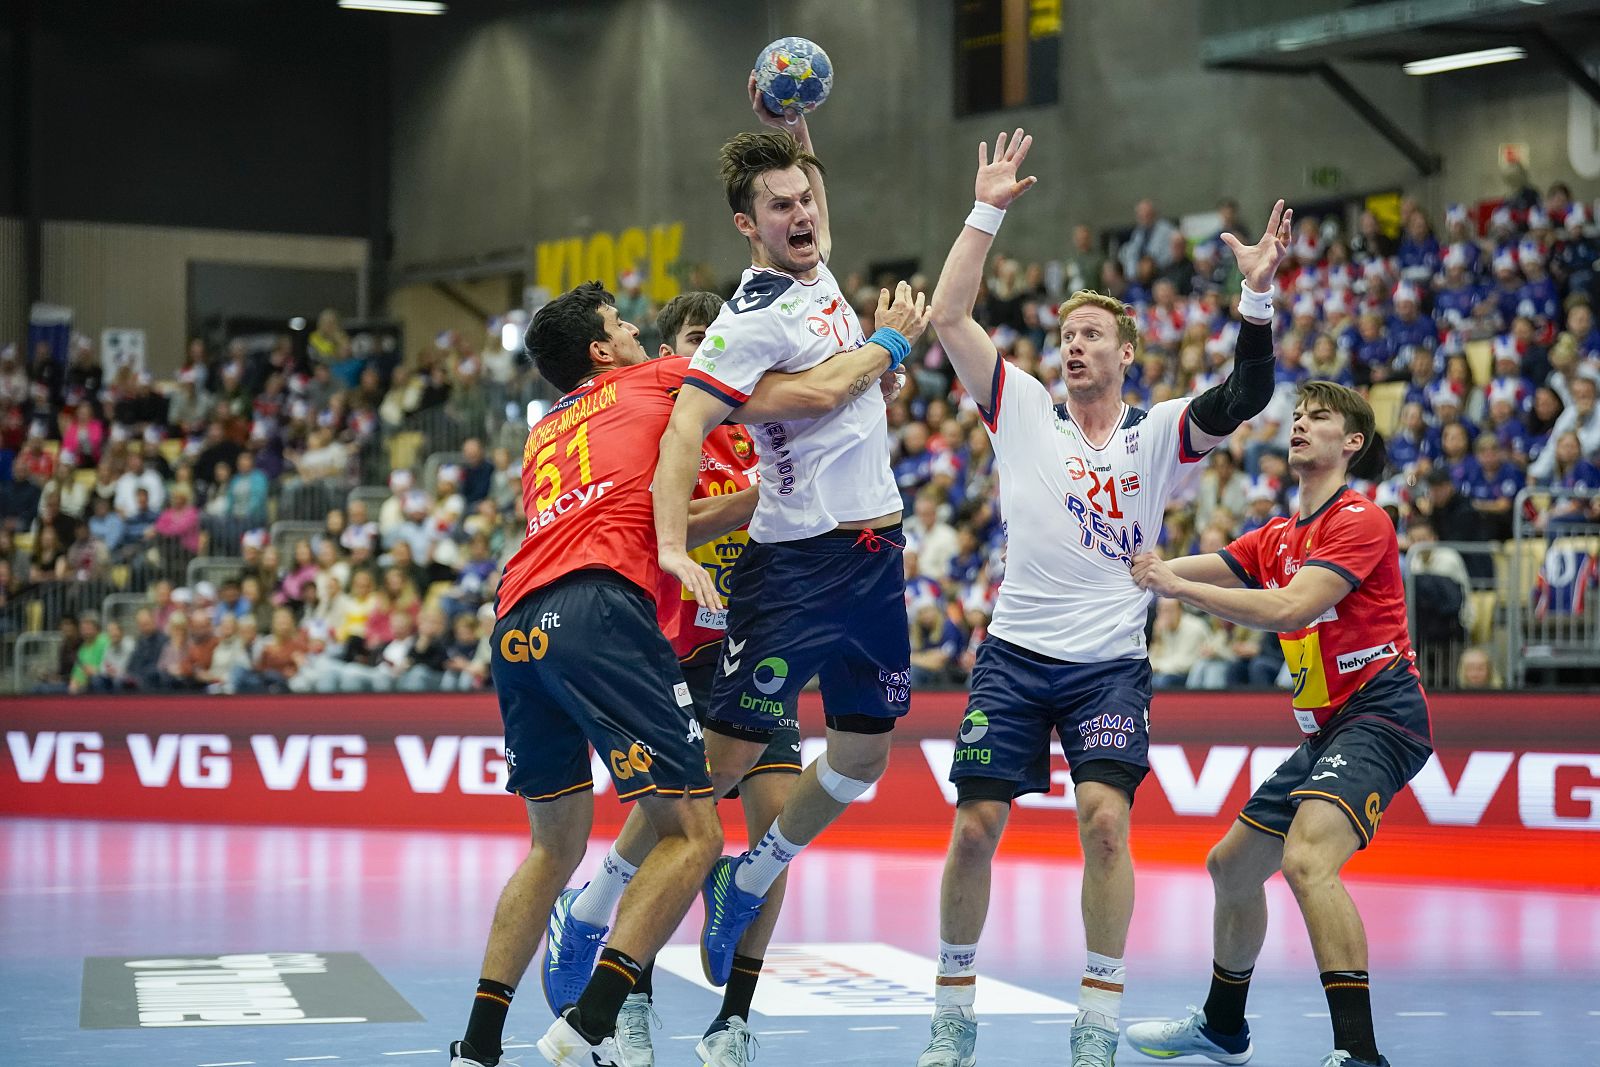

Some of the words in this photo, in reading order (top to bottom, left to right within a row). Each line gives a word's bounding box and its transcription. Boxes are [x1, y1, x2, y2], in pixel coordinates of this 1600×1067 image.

[534, 421, 592, 513] 51
[528, 481, 614, 537] sacyr
[1086, 471, 1124, 519] 21
[1065, 493, 1144, 556] REMA
[540, 611, 561, 631] fit
[501, 626, 549, 663] GO
[739, 692, 785, 717] bring
[1078, 713, 1136, 737] REMA
[1083, 731, 1128, 750] 1000
[6, 731, 104, 785] VG
[126, 733, 232, 790] VG
[249, 735, 368, 792] VG
[394, 736, 507, 796] VG
[610, 742, 653, 780] GO
[955, 746, 992, 764] bring
